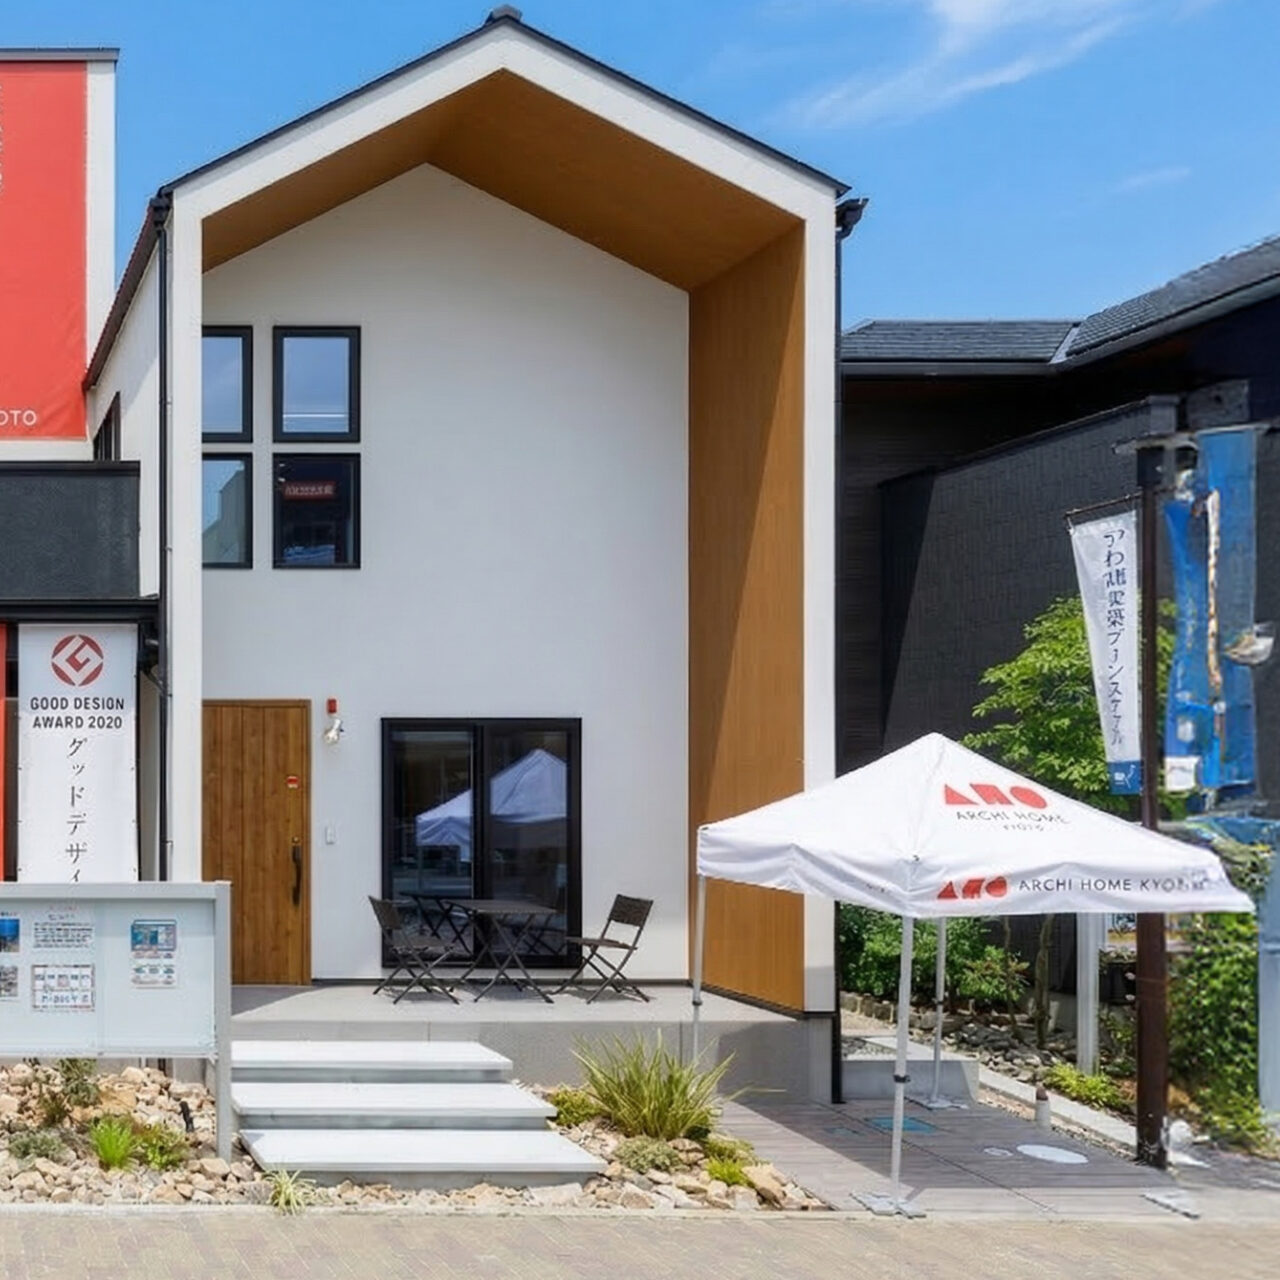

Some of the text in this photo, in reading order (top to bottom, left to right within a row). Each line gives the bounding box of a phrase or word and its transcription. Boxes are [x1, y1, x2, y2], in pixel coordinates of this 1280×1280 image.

[30, 696, 125, 711] GOOD DESIGN
[32, 715, 123, 730] AWARD 2020
[1019, 878, 1072, 892] ARCHI
[1081, 878, 1132, 892] HOME
